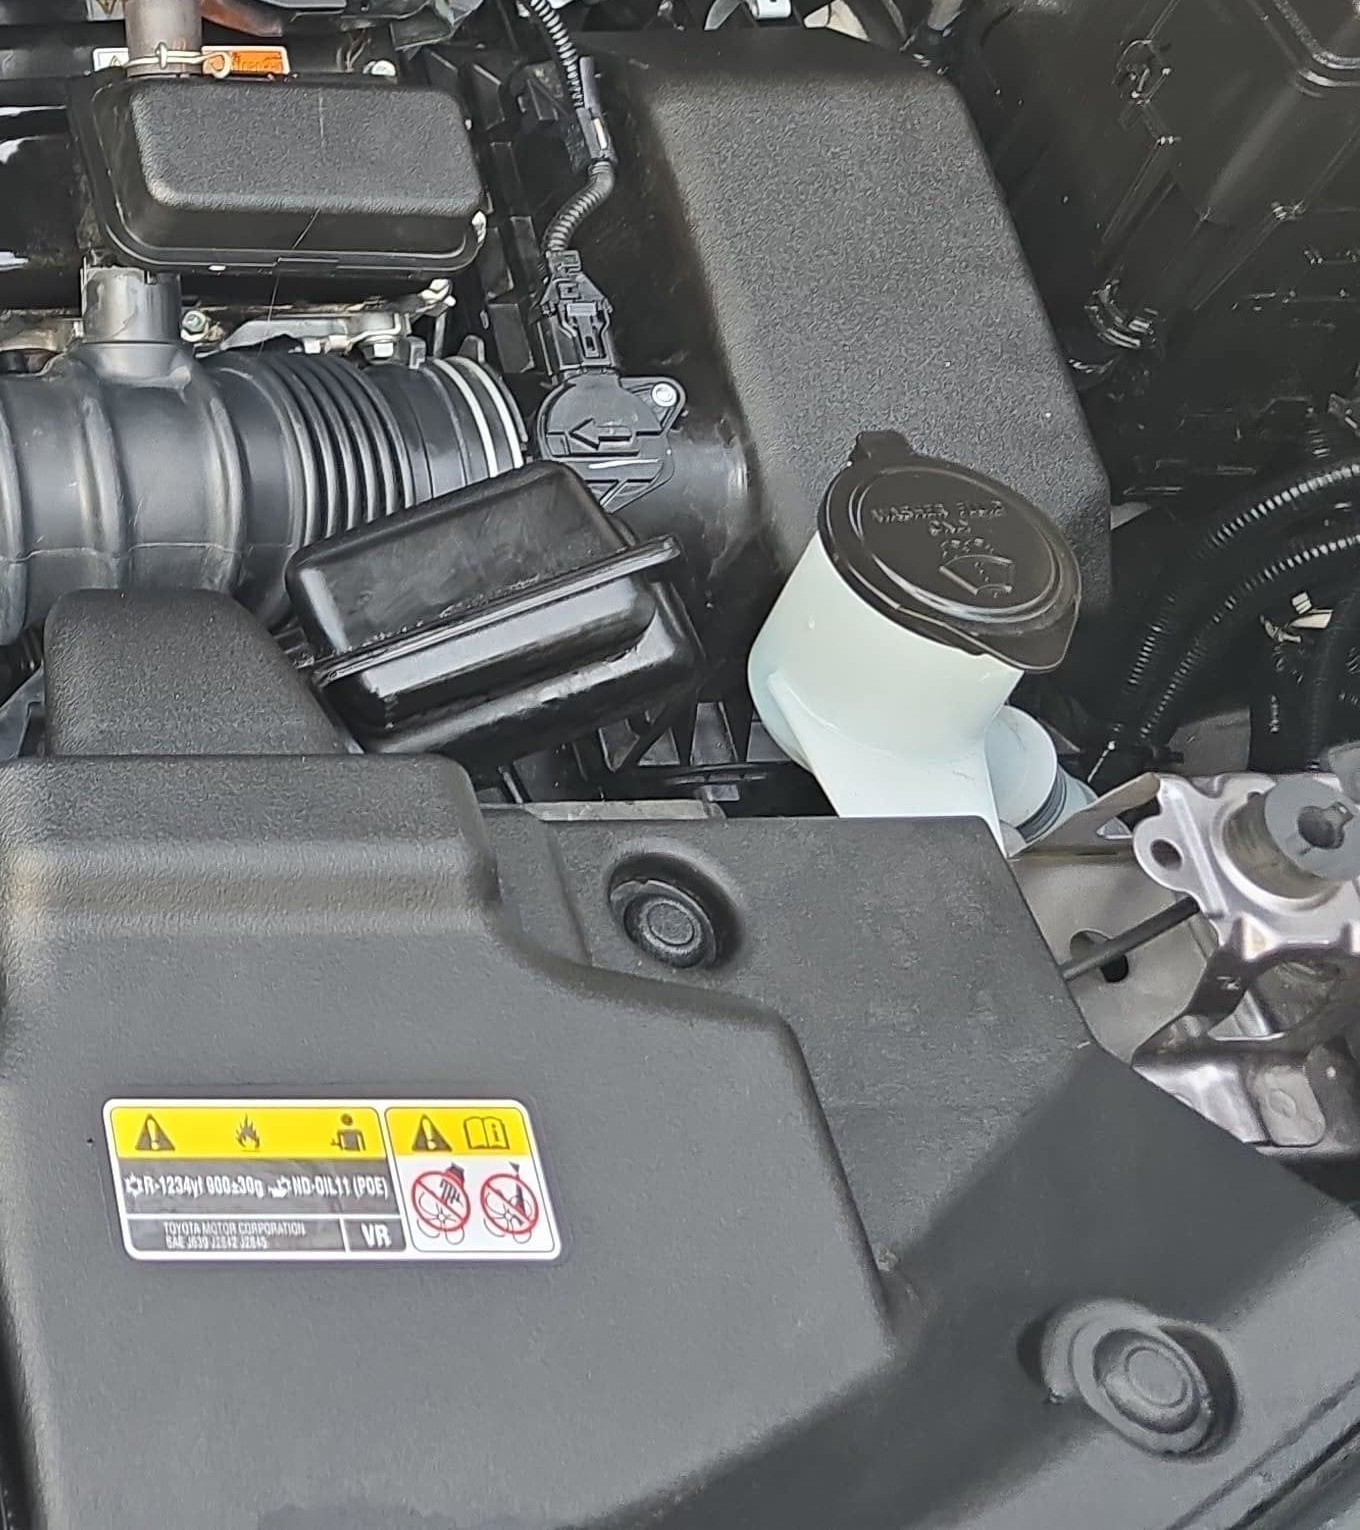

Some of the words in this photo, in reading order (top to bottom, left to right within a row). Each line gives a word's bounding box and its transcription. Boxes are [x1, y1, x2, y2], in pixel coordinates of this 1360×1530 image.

[353, 1176, 389, 1200] (POE)
[163, 1221, 201, 1235] TOYOTA
[202, 1221, 237, 1236] MOTOR
[238, 1222, 307, 1236] CORPORATION
[360, 1223, 392, 1248] VR
